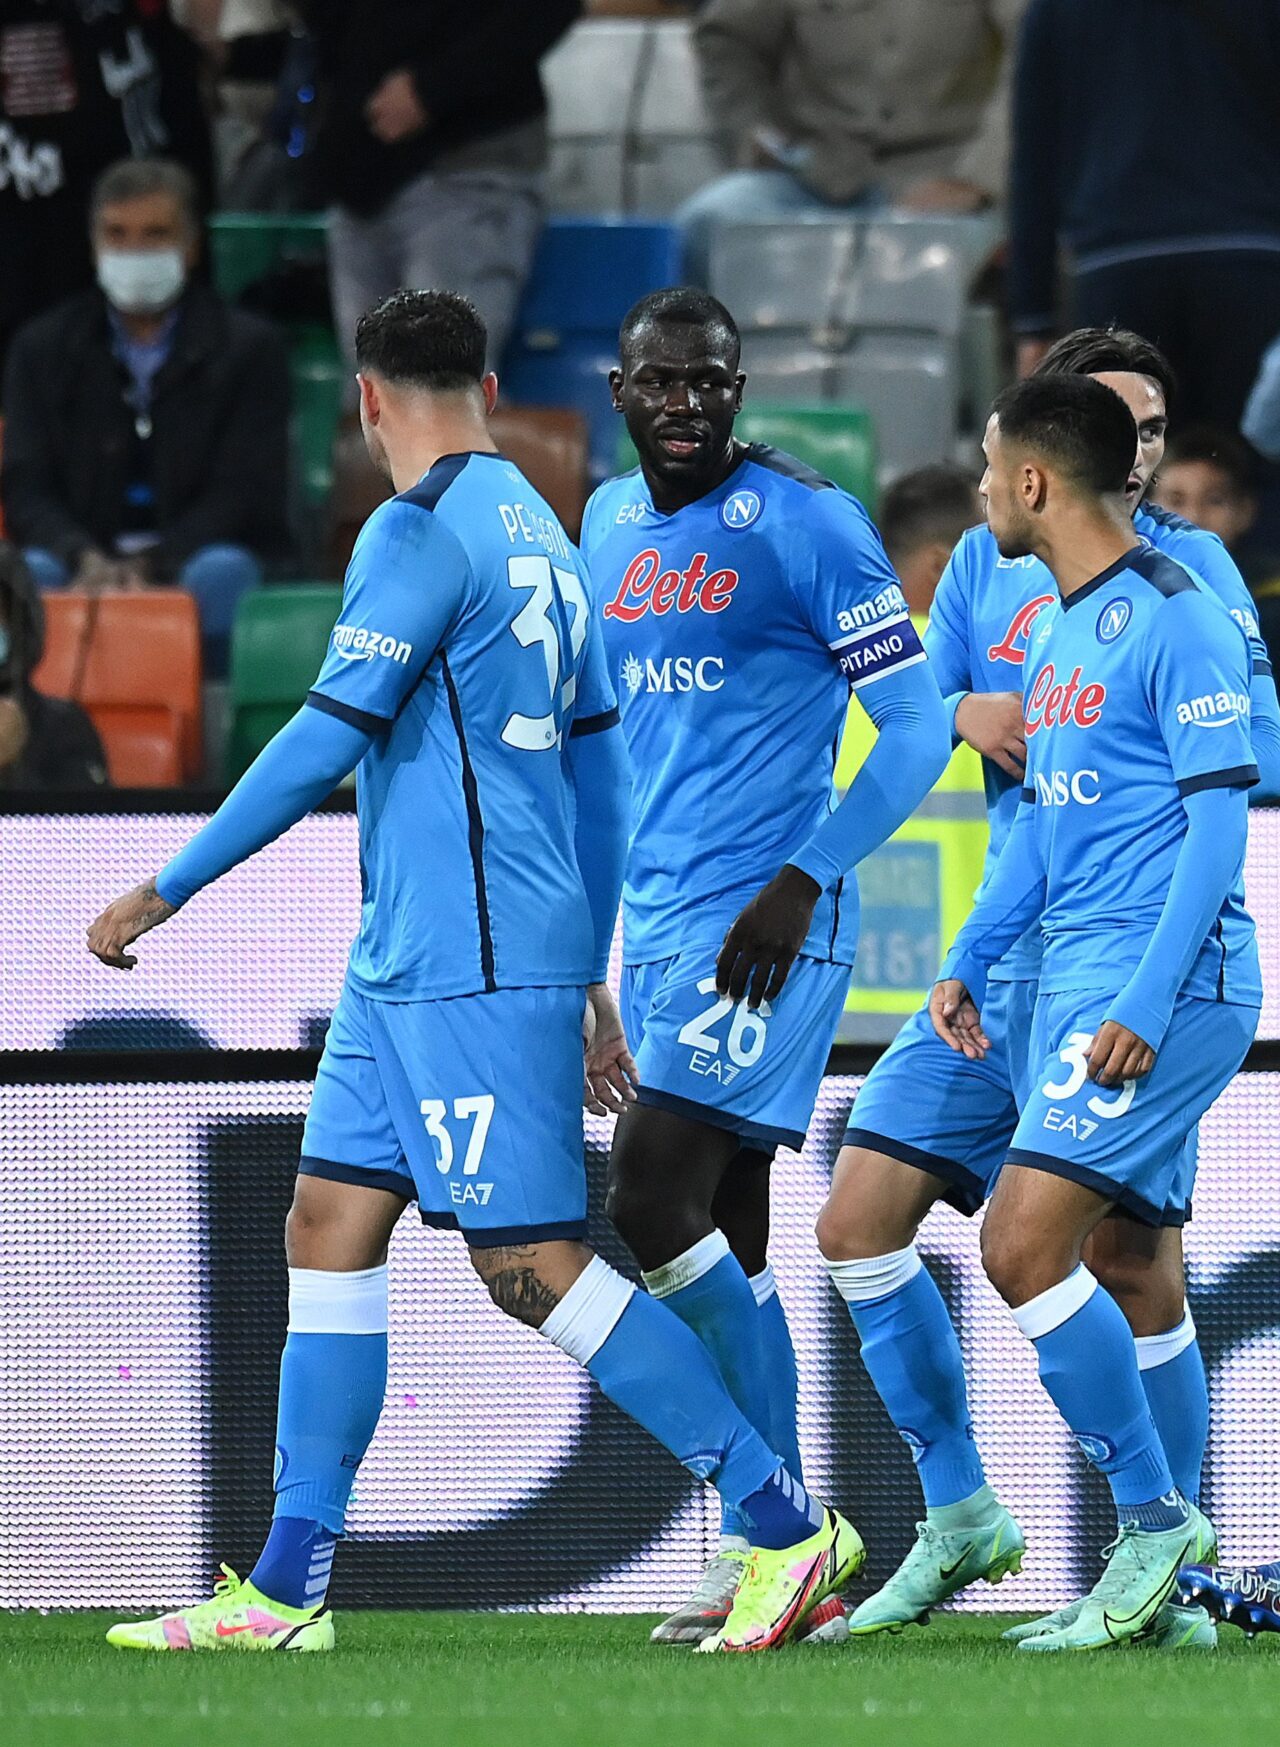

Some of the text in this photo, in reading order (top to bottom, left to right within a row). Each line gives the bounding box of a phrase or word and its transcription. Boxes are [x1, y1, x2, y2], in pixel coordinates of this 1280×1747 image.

[603, 547, 739, 623] Lete
[333, 624, 413, 664] amazon
[840, 635, 903, 674] PITANO
[645, 657, 725, 692] MSC
[1025, 663, 1106, 738] Lete
[1034, 769, 1101, 807] MSC
[677, 977, 772, 1067] 26
[688, 1050, 740, 1087] EA7
[420, 1095, 495, 1176] 37
[1043, 1107, 1099, 1141] EA7
[450, 1182, 494, 1206] EA7
